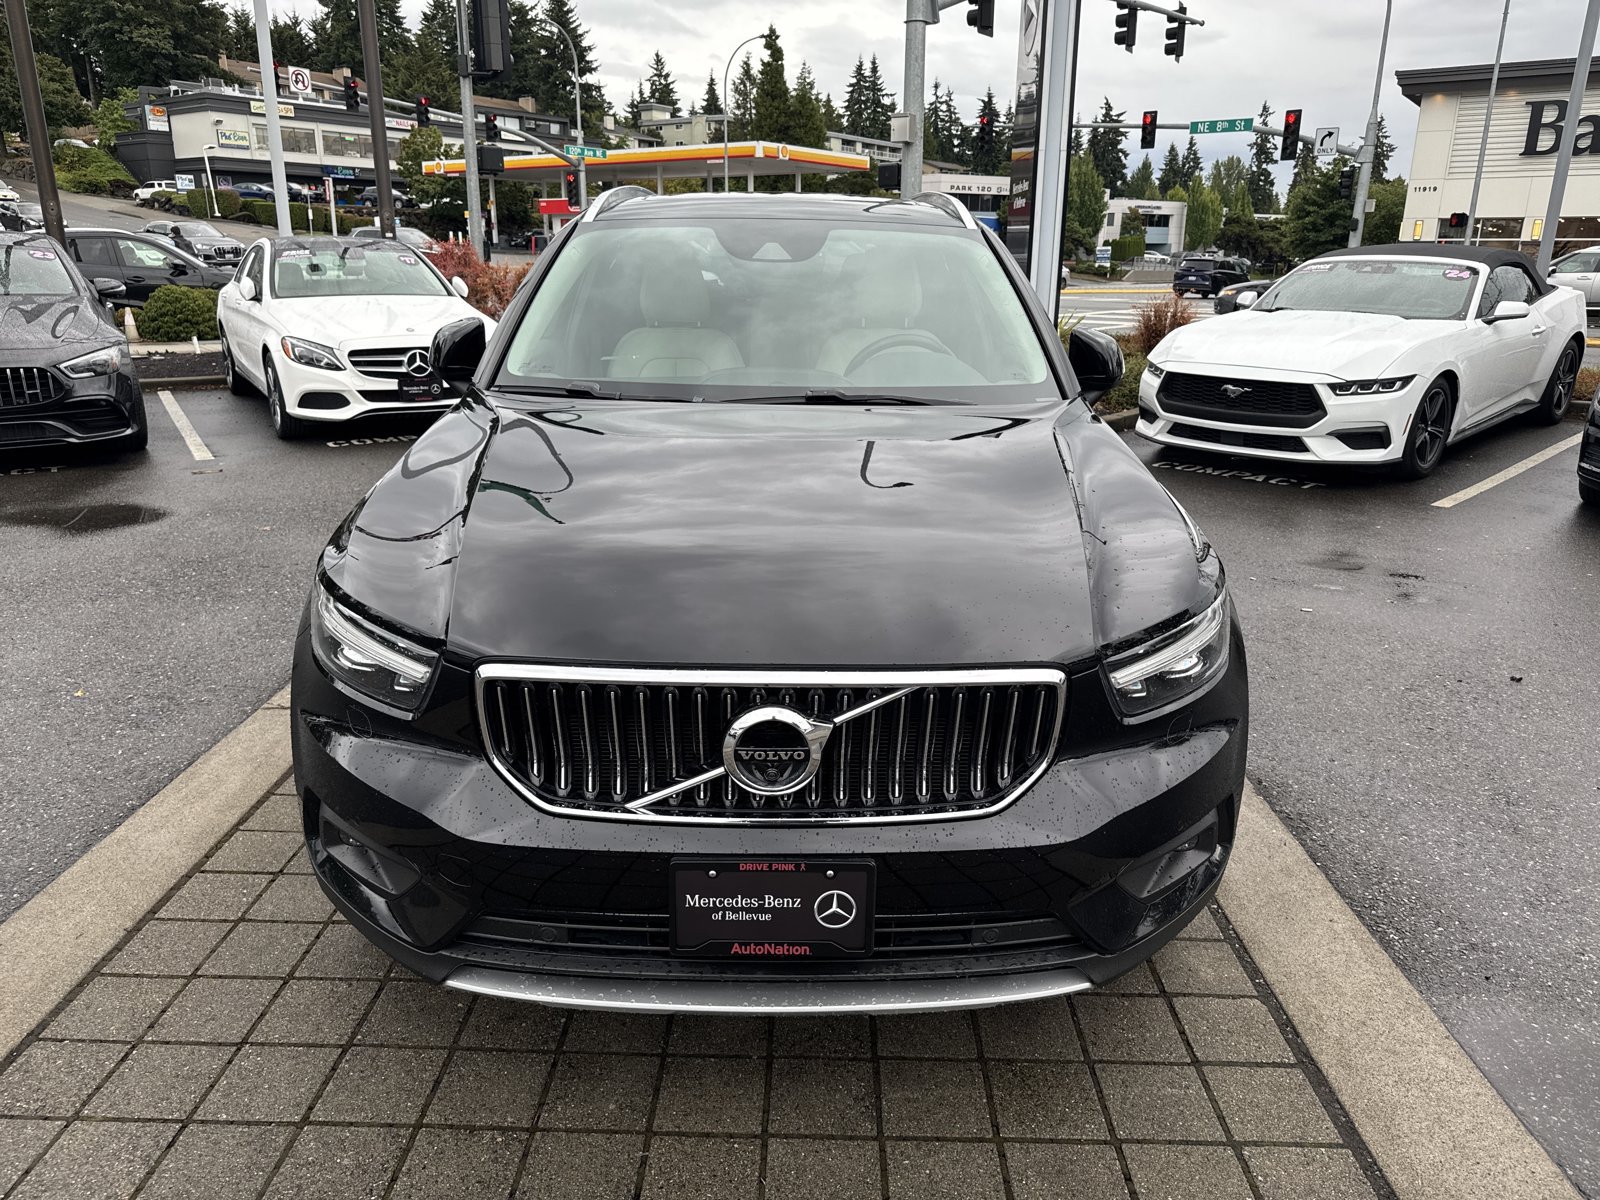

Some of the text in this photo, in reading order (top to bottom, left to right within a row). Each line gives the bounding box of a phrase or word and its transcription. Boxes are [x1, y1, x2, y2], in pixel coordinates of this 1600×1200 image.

[1198, 120, 1245, 133] NE 8th St
[950, 184, 973, 192] PARK
[1152, 461, 1327, 489] COMPACT
[737, 751, 805, 760] VOLVO
[739, 863, 795, 871] DRIVE PINK
[684, 894, 801, 908] Mercedes-Benz
[711, 911, 772, 921] of Bellevue
[730, 942, 810, 955] AutoNation
